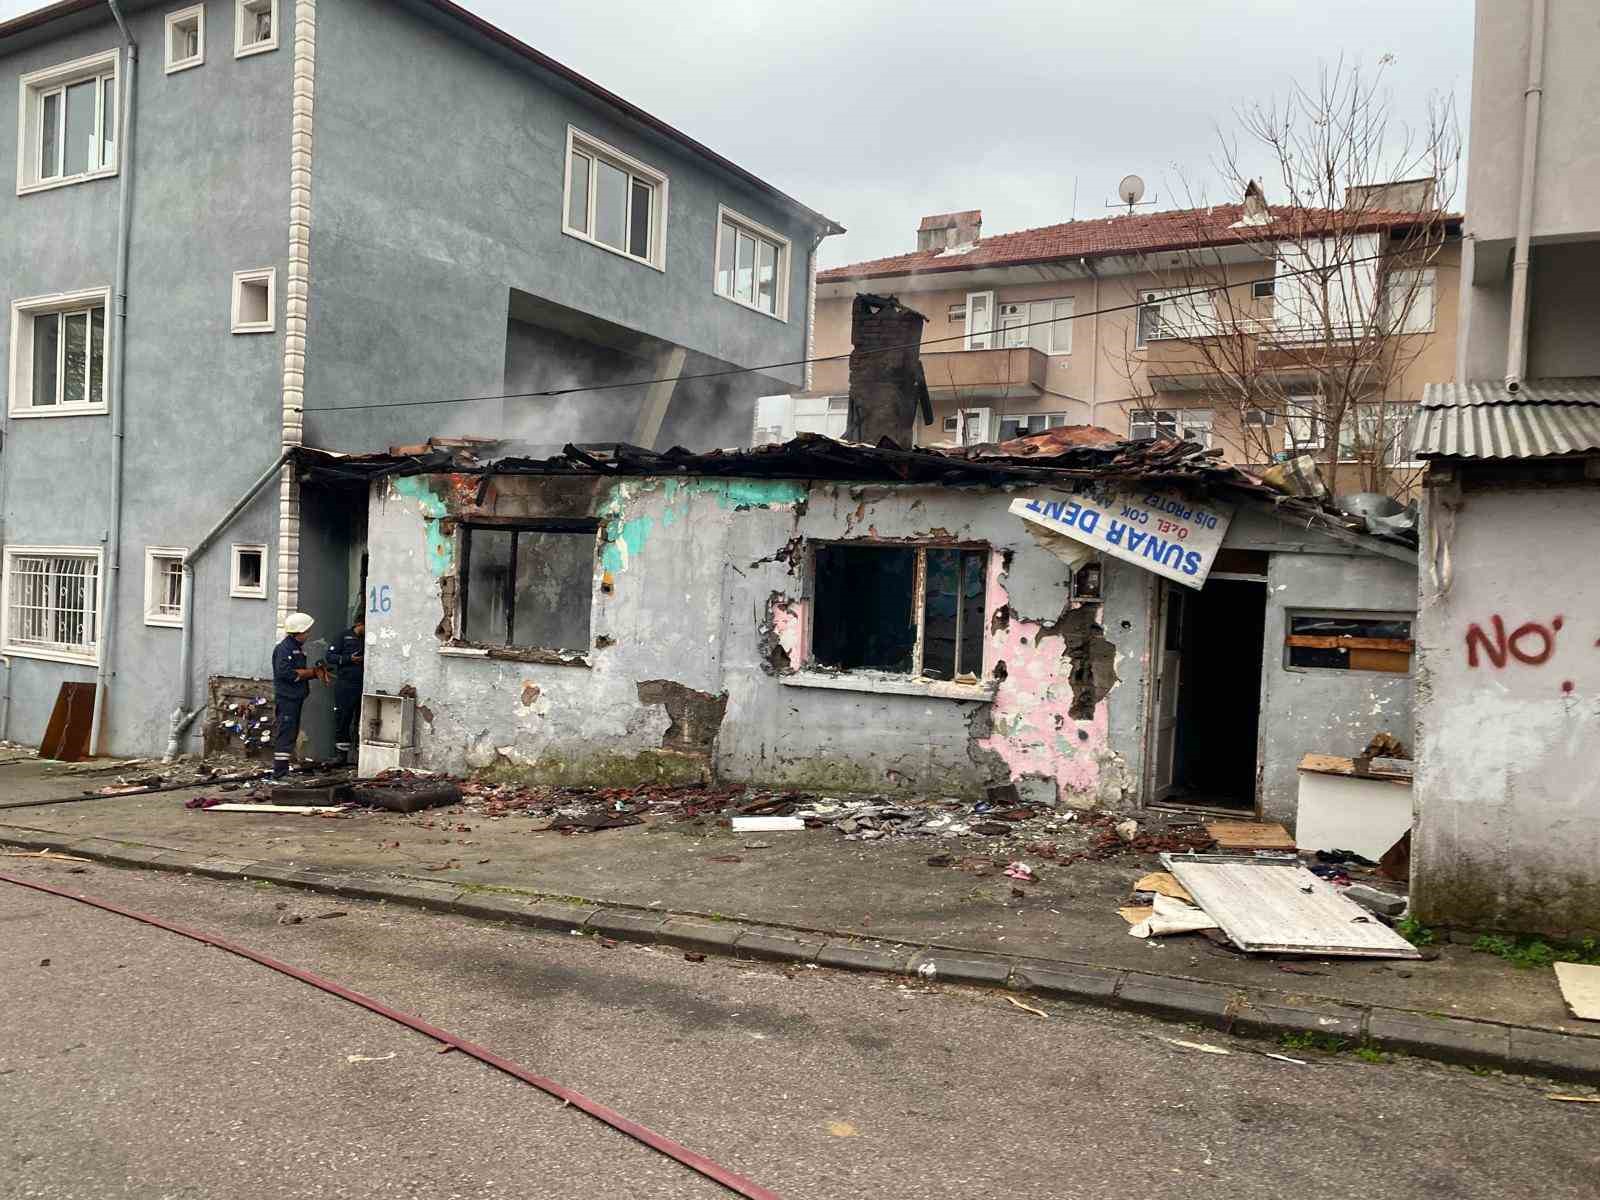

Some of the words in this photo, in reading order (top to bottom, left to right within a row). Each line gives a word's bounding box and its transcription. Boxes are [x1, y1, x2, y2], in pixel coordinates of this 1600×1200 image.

[1025, 499, 1100, 534] DENT
[1105, 519, 1201, 576] SUNAR
[369, 585, 392, 613] 16
